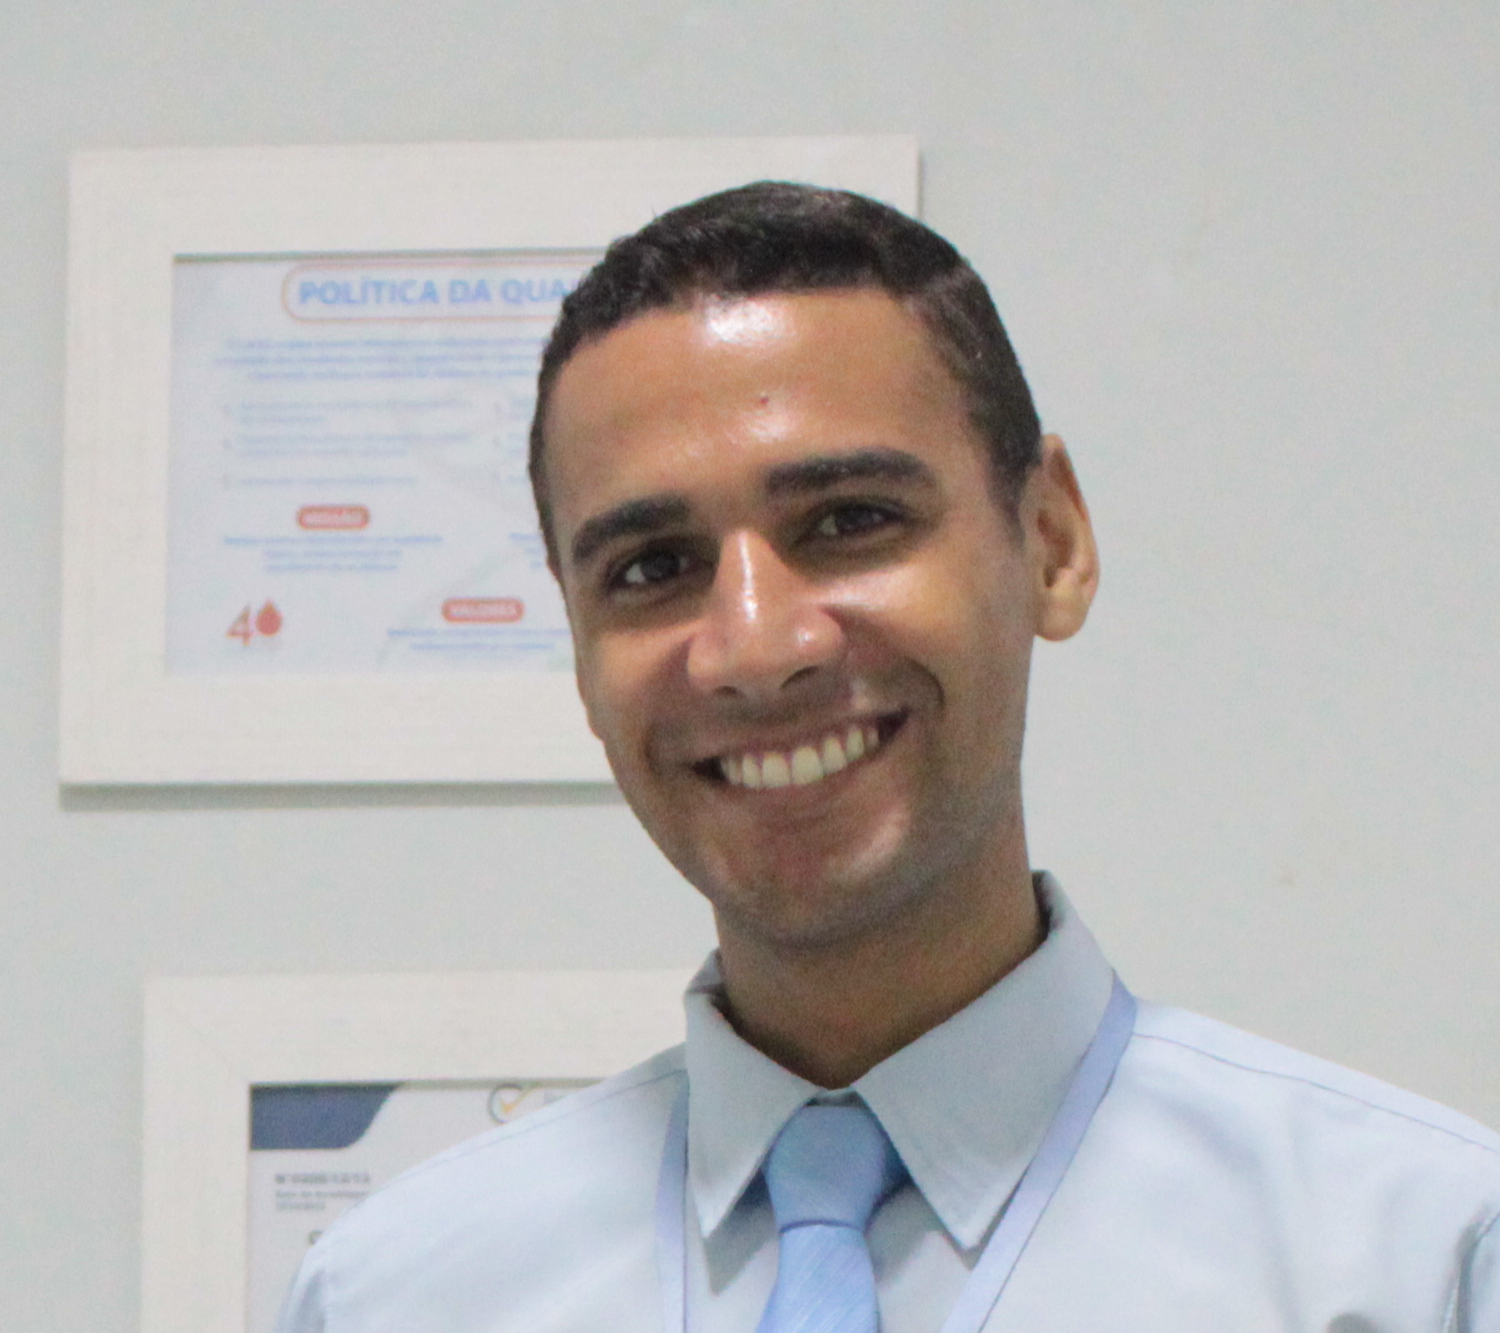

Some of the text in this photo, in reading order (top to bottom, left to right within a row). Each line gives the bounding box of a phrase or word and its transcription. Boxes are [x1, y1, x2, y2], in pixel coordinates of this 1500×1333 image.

[298, 274, 580, 304] POLÍTICA DA QUA
